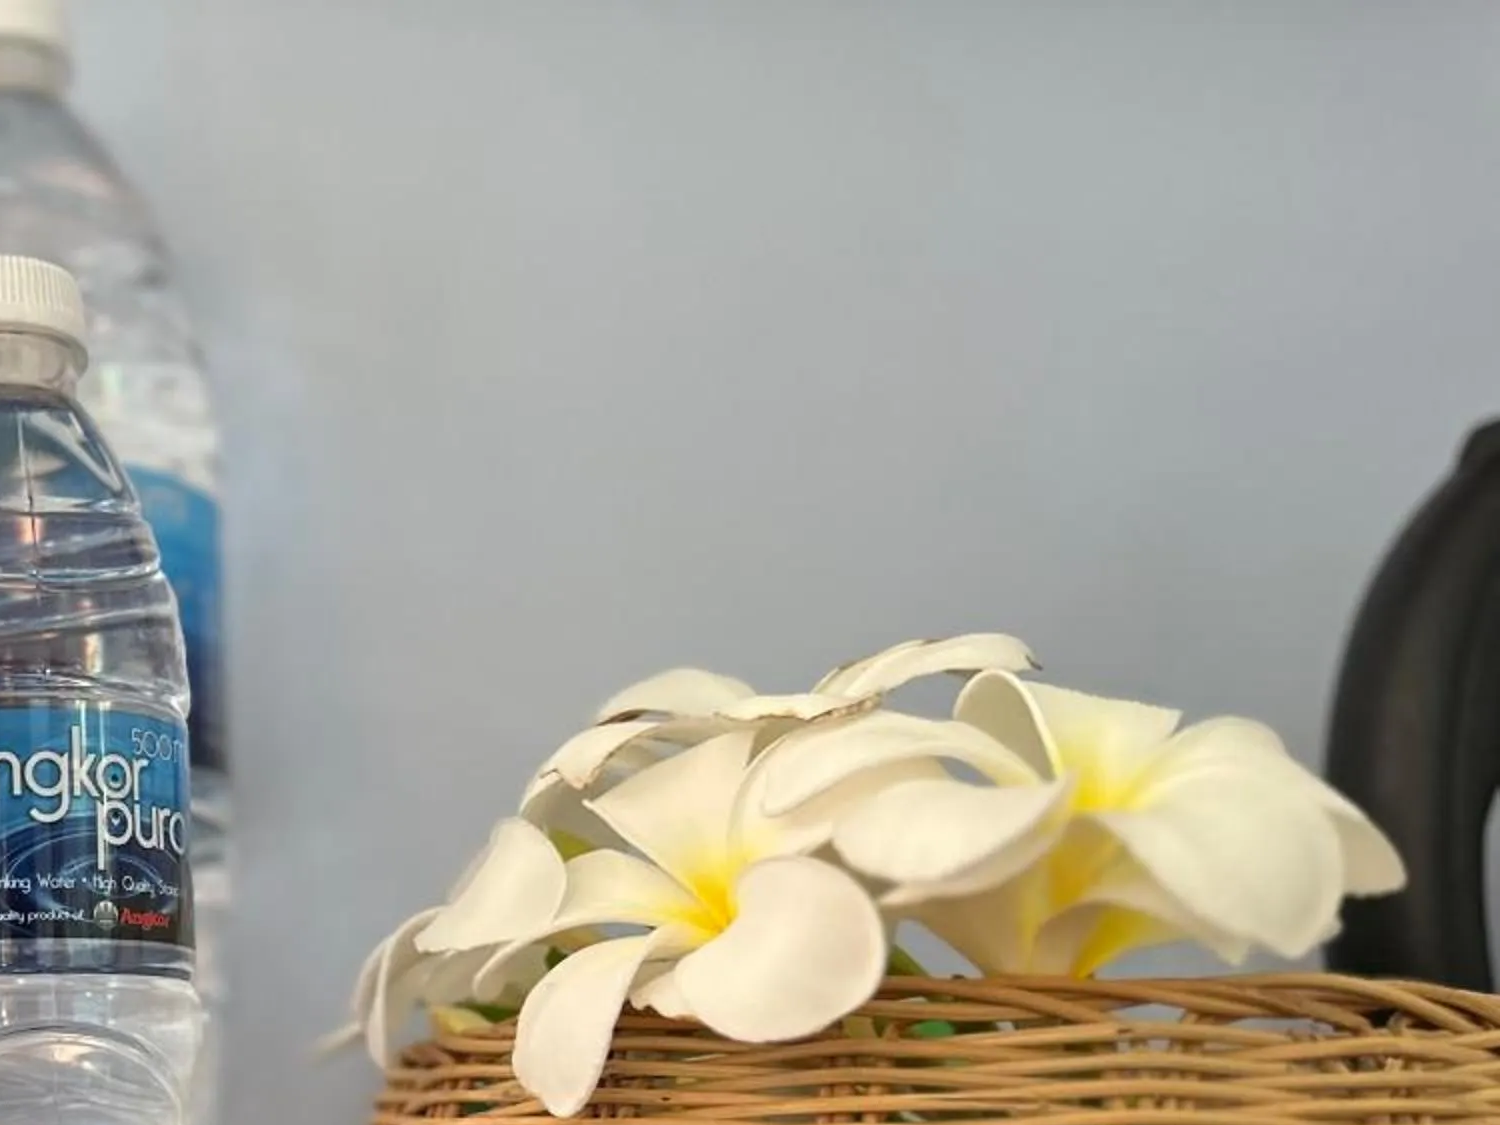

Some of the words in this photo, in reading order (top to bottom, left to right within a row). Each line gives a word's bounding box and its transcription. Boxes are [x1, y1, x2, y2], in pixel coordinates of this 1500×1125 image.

[36, 873, 76, 889] Water
[27, 909, 69, 924] product
[121, 907, 170, 930] Angkor
